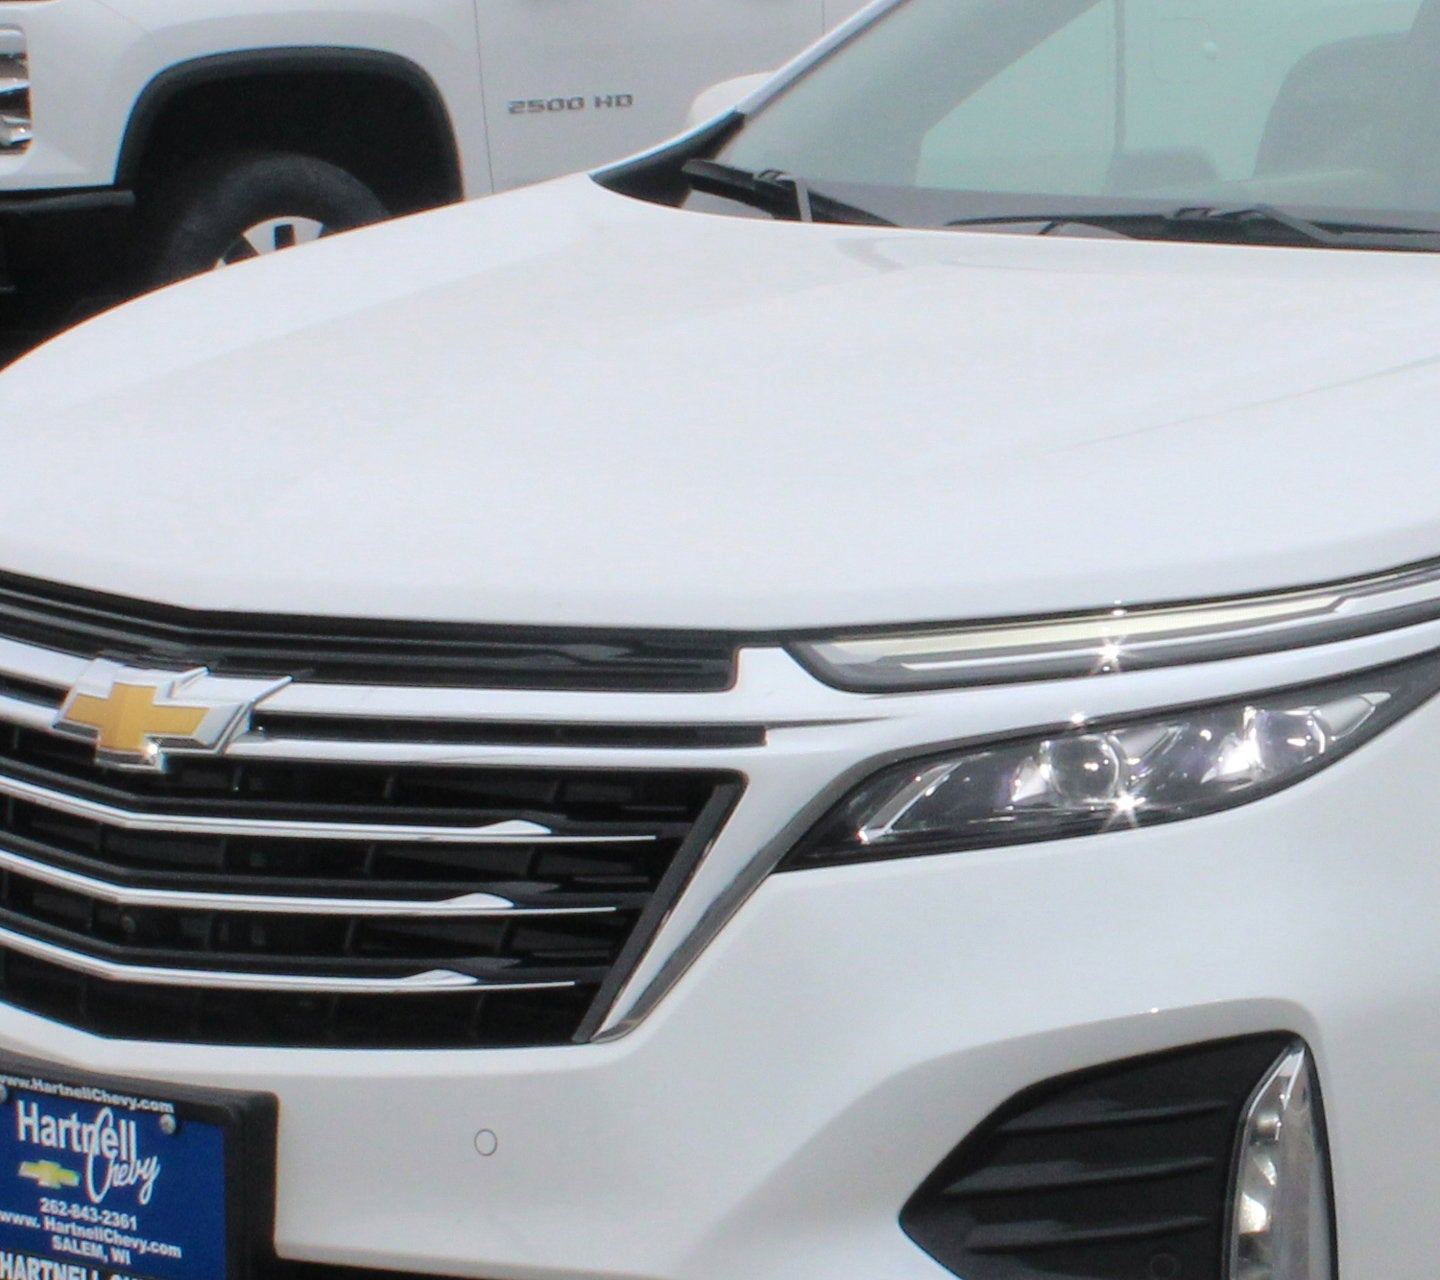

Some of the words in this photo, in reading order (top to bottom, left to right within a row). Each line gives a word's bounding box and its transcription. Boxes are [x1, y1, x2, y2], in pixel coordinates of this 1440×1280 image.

[508, 95, 586, 115] 2500
[593, 93, 634, 110] HD
[16, 1099, 137, 1162] Hartnell
[85, 1106, 161, 1205] Chevy
[43, 1215, 183, 1259] HartnellChevy.com
[51, 1234, 109, 1264] SALEM,
[109, 1246, 132, 1266] WI
